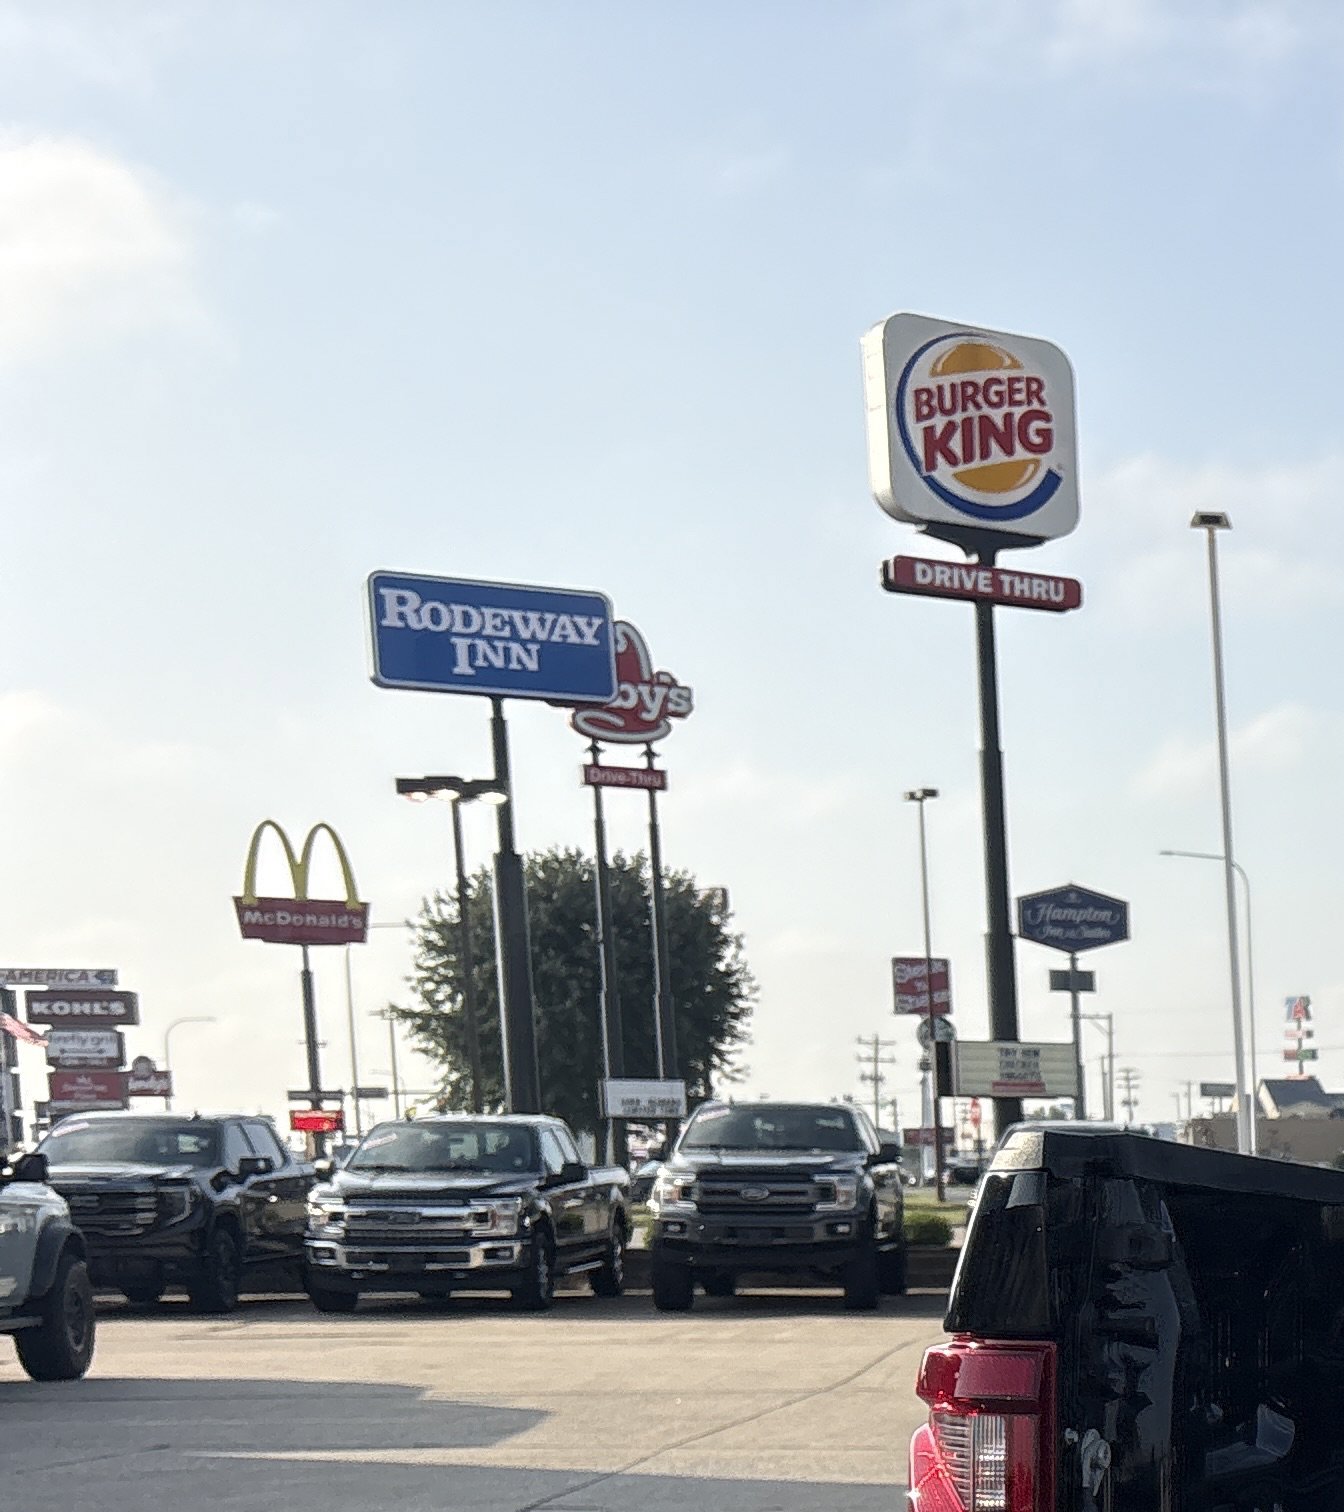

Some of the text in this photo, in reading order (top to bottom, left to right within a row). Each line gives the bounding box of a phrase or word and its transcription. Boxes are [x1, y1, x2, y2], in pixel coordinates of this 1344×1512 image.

[913, 375, 1047, 425] BURGER
[922, 408, 1055, 473] KING
[914, 562, 1065, 603] DRIVE THRU
[242, 910, 364, 930] McDonald's
[1025, 904, 1119, 925] Hampton
[6, 971, 89, 982] AMERICA
